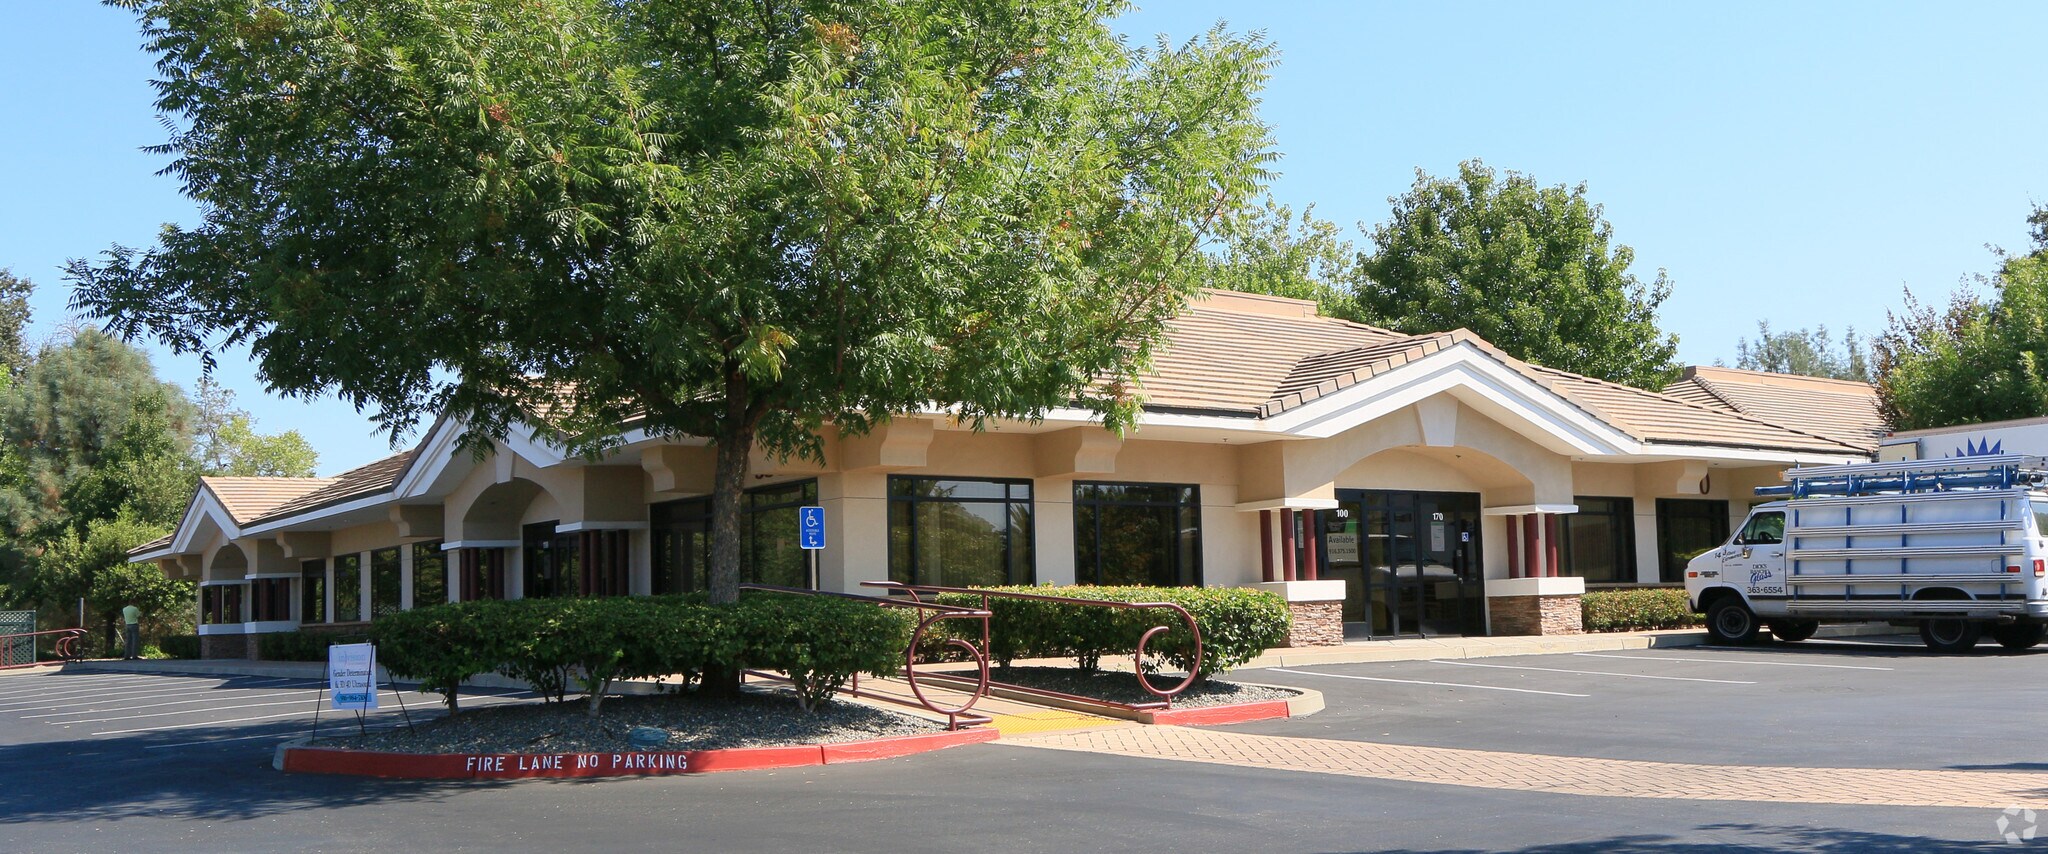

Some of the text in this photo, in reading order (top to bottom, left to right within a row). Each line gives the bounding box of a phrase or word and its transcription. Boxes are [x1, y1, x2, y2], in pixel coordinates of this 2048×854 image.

[1336, 509, 1349, 518] 100
[1432, 512, 1444, 521] 170
[1328, 535, 1355, 544] Available
[466, 754, 688, 772] FIRE LANE NO PARKING
